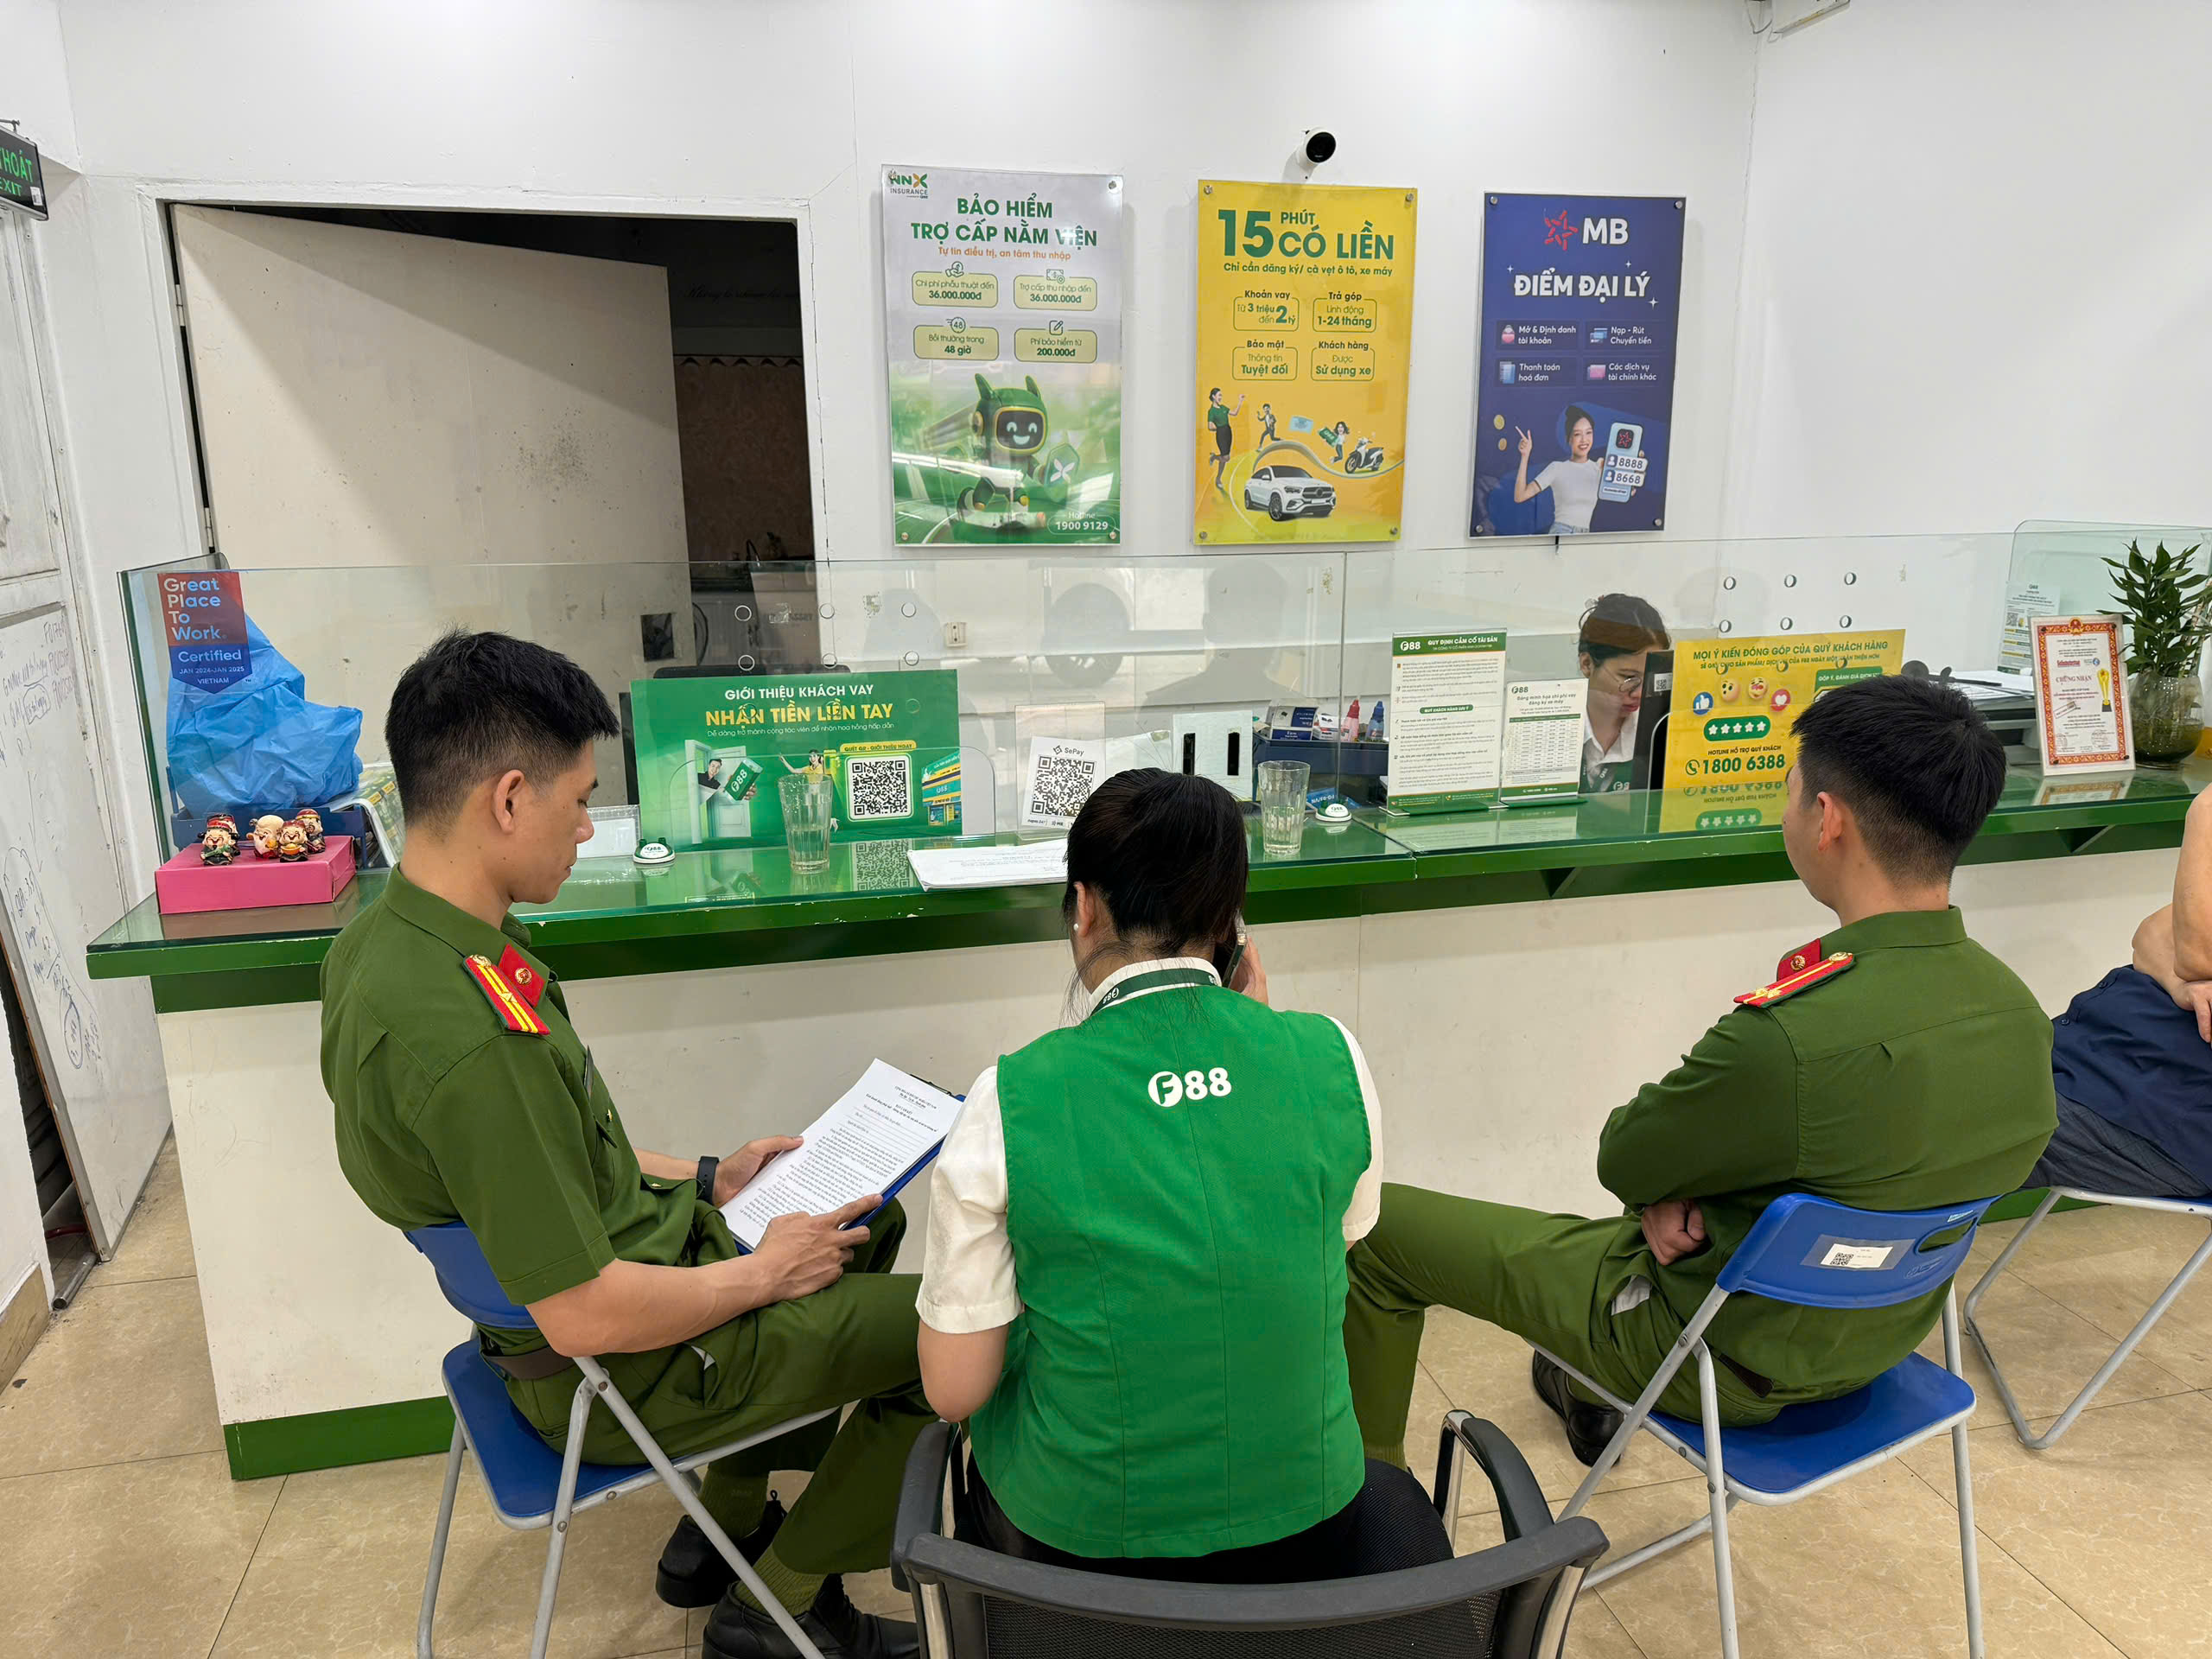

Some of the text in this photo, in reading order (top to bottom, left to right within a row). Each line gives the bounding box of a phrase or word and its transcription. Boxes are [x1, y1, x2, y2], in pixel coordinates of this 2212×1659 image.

[957, 193, 1052, 219] BẢO HIỂM
[1281, 209, 1316, 226] PHÚT
[911, 219, 1097, 251] TRỢ CẤP NẰM VIỆN
[1217, 209, 1274, 257] 15
[1582, 218, 1629, 245] MB
[1279, 220, 1394, 260] CÓ LIỀN
[938, 246, 949, 257] Tự
[951, 247, 962, 256] tin
[964, 247, 983, 257] điều
[986, 248, 997, 259] trị,
[1014, 250, 1030, 258] tâm
[1049, 251, 1071, 262] nhập
[1224, 262, 1240, 272] Chỉ
[1242, 262, 1261, 272] cần
[1262, 263, 1286, 275] đăng
[1288, 264, 1303, 275] ký/
[1306, 264, 1319, 274] cà
[1322, 266, 1335, 276] vẹt
[1338, 265, 1344, 274] ô
[1346, 265, 1357, 276] tô,
[1374, 266, 1393, 276] máy
[1514, 267, 1651, 303] ĐIỂM ĐẠI LÝ
[929, 290, 982, 301] 36.000.000đ
[1030, 294, 1082, 304] 36.000.000đ
[1245, 289, 1291, 301] Khoản vay
[1329, 291, 1362, 302] Trả góp
[1248, 303, 1254, 313] 3
[1256, 304, 1274, 314] triệu
[1327, 305, 1363, 315] Linh động
[1259, 306, 1296, 325] đến 2 tỷ
[1318, 316, 1372, 328] 1-24 tháng
[1519, 326, 1531, 334] Mở
[1539, 326, 1556, 335] Định
[1559, 326, 1576, 334] danh
[1611, 327, 1625, 336] Nạp
[1632, 326, 1644, 334] Rút
[1247, 340, 1284, 349] Bảo mật
[1319, 341, 1369, 351] Khách hàng
[1529, 336, 1552, 345] khoản
[1611, 336, 1652, 346] Chuyển tiền
[957, 345, 971, 356] giờ
[1037, 347, 1076, 358] 200.000đ
[1248, 353, 1283, 364] Thông tin
[1332, 355, 1353, 364] Được
[1242, 363, 1288, 377] Tuyệt đối
[1316, 364, 1327, 375] Sử
[1331, 365, 1356, 378] dụng
[1520, 363, 1560, 372] Thanh toán
[1609, 362, 1649, 372] Các dịch vụ
[1519, 373, 1549, 382] hoá đơn
[1618, 455, 1643, 469] 8888
[1616, 473, 1641, 485] 8668
[1056, 521, 1109, 531] 1900 9129
[164, 577, 220, 593] Great
[168, 594, 221, 609] Place
[168, 611, 191, 625] To
[178, 649, 242, 663] Certified
[1694, 640, 1888, 661] MỌI Ý KIẾN ĐÓNG GÓP CỦA QUÝ KHÁCH HÀNG
[195, 666, 227, 675] 2024-JAN
[725, 683, 874, 702] GIỚI THIỆU KHÁCH VAY
[706, 698, 893, 729] NHẬN TIỀN LIỀN TAY
[852, 724, 868, 733] hồng
[868, 723, 880, 732] hấp
[1065, 747, 1084, 757] SePay
[1703, 753, 1786, 774] 1800 6388
[1148, 1067, 1232, 1108] F88
